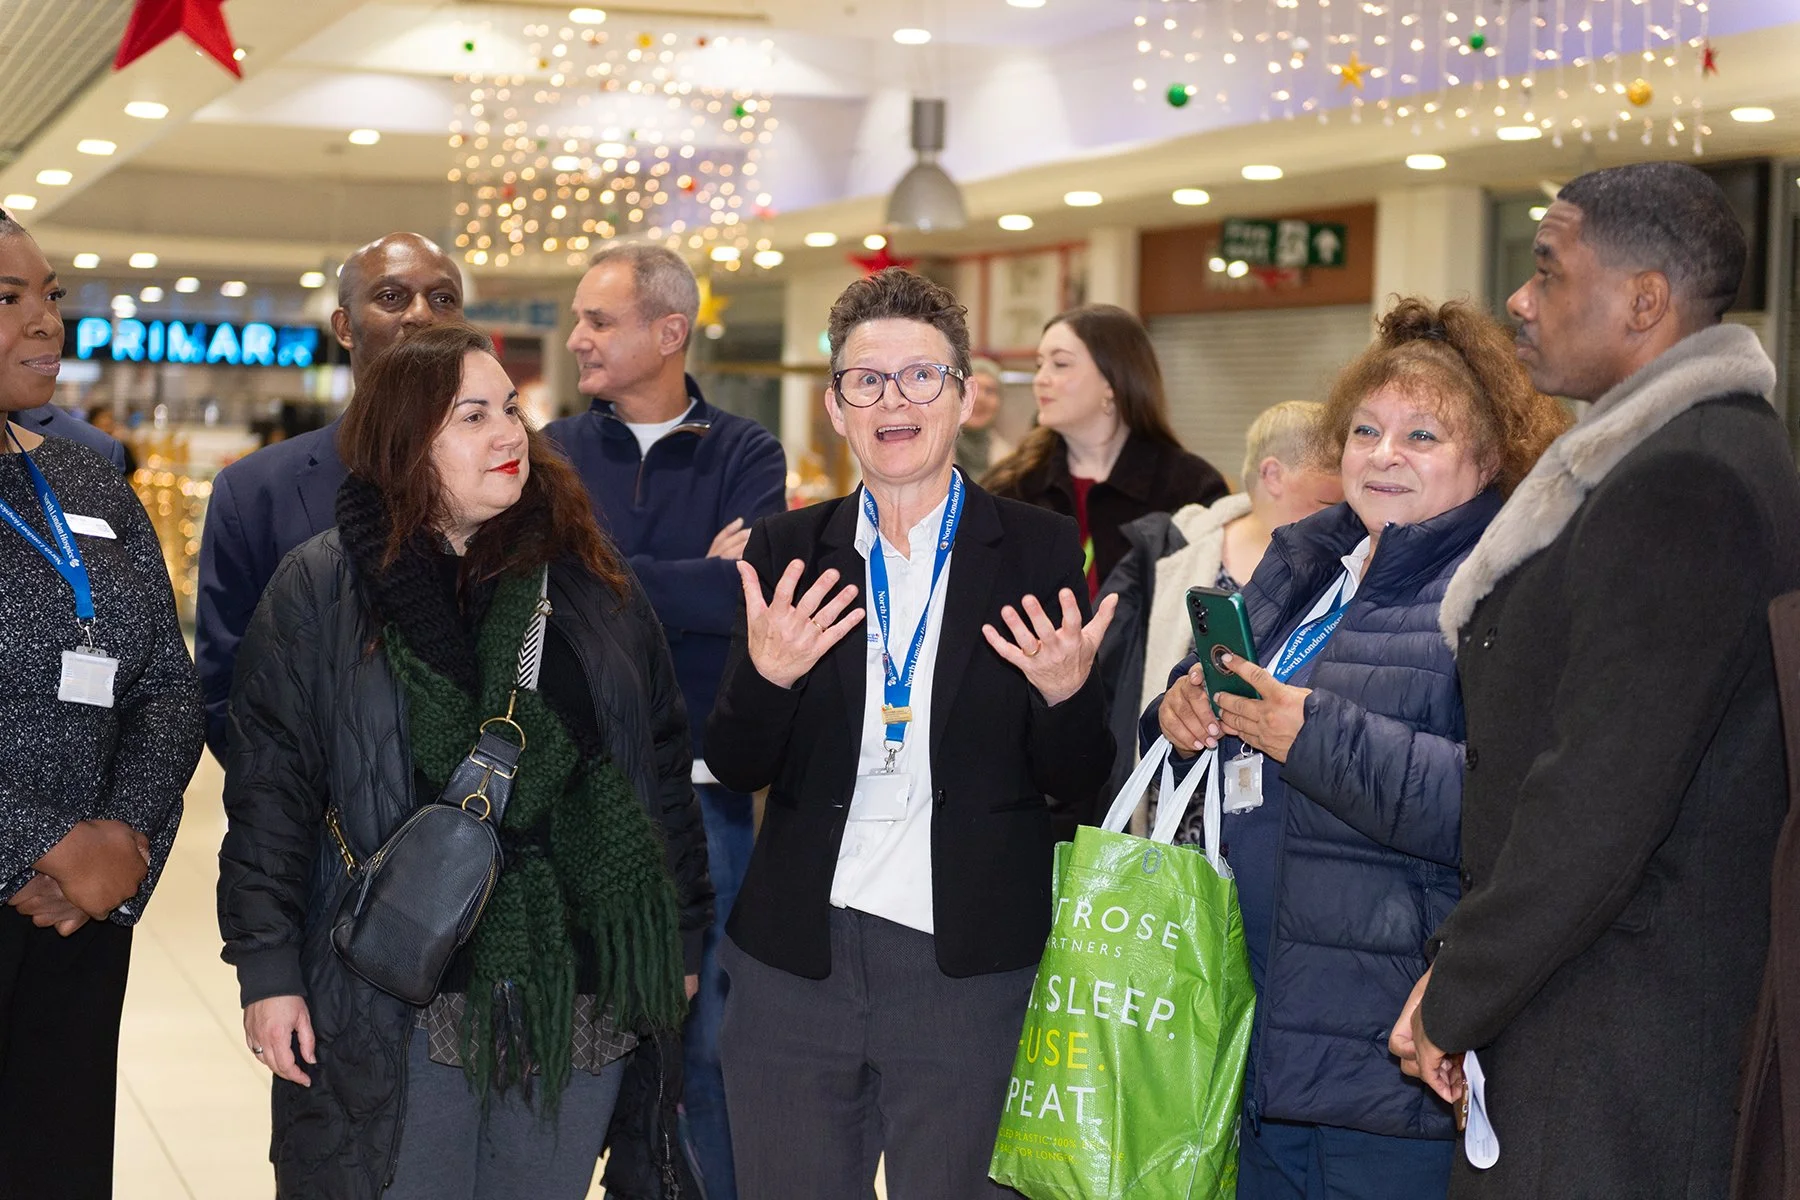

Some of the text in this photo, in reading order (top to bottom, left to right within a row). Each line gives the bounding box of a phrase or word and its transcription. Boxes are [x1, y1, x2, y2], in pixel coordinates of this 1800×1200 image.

[43, 492, 75, 559] North London Hospice
[943, 520, 954, 541] North
[950, 491, 960, 520] London
[21, 526, 46, 548] London
[44, 547, 64, 566] North
[878, 590, 887, 615] North
[1281, 656, 1302, 677] North
[1299, 630, 1327, 659] London
[905, 664, 916, 688] North
[1046, 974, 1176, 1040] SLEEP.
[1005, 1076, 1103, 1126] PEAT.
[1014, 1130, 1049, 1145] PLASTIC
[1053, 1137, 1077, 1150] 100%
